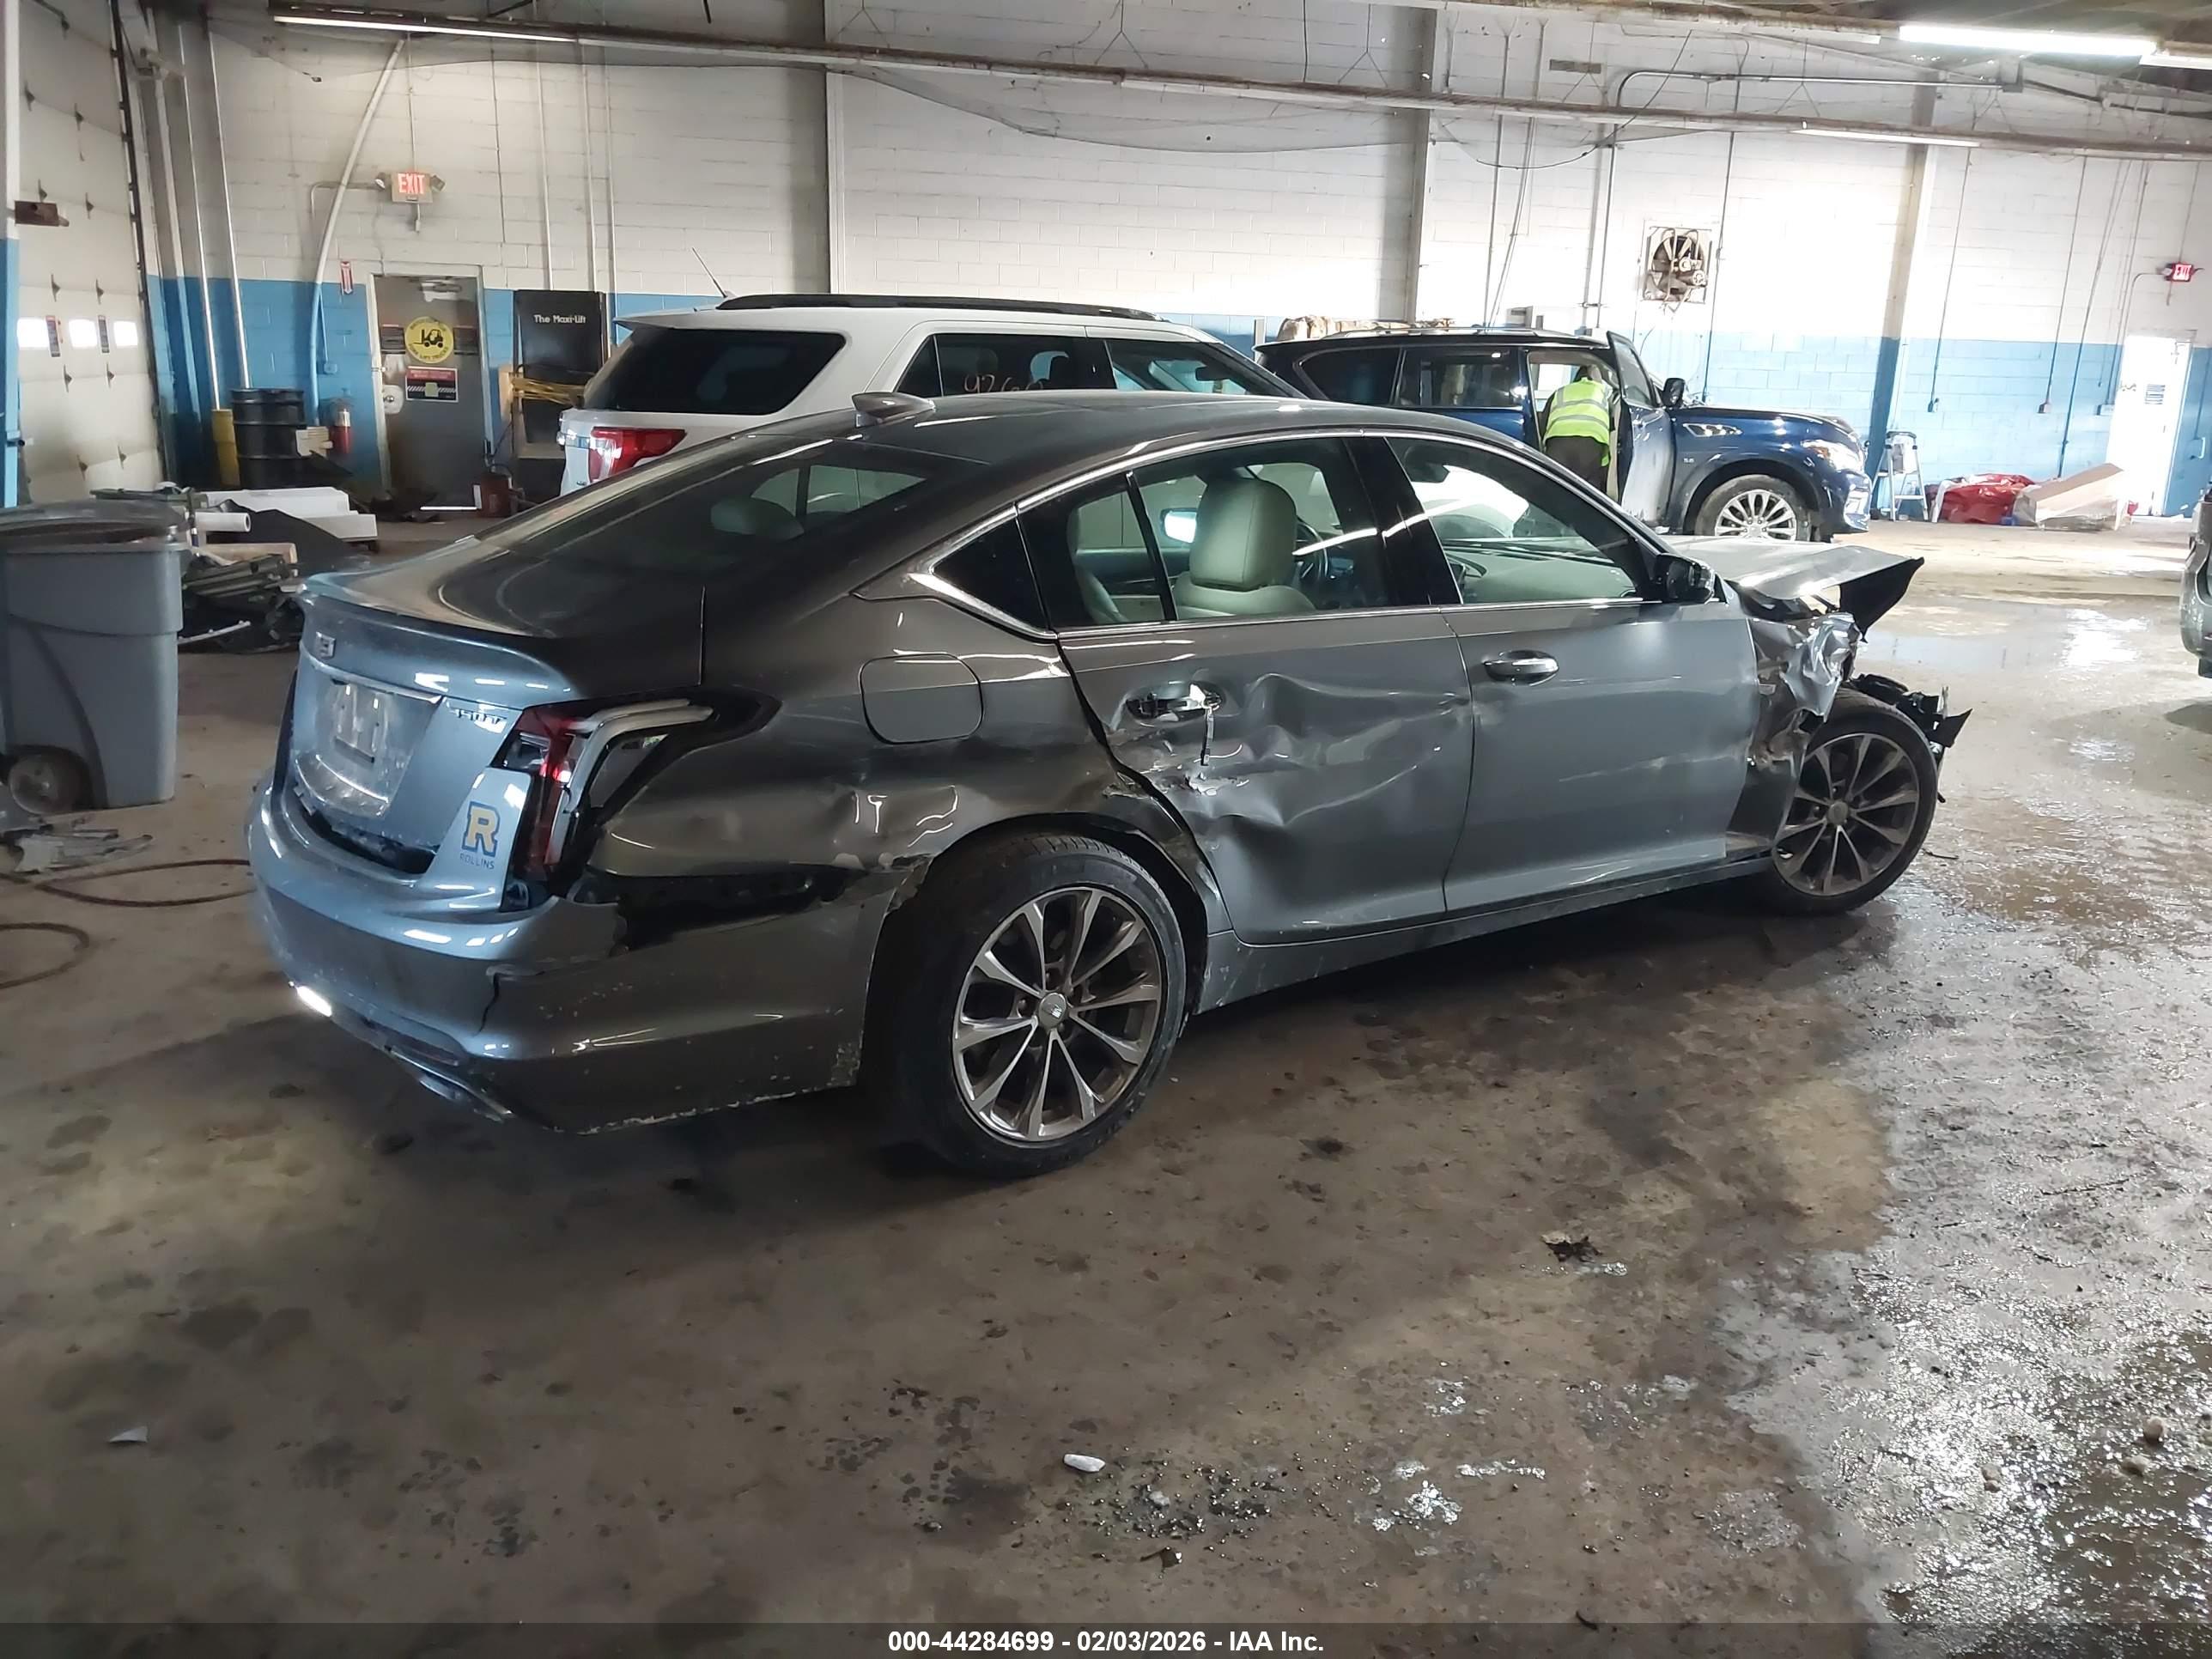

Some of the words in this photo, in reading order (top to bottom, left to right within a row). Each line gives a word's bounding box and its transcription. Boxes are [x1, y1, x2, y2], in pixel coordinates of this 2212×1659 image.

[398, 173, 426, 195] EXIT
[533, 314, 550, 324] The
[461, 800, 501, 857] R
[459, 853, 495, 870] ROLLINS
